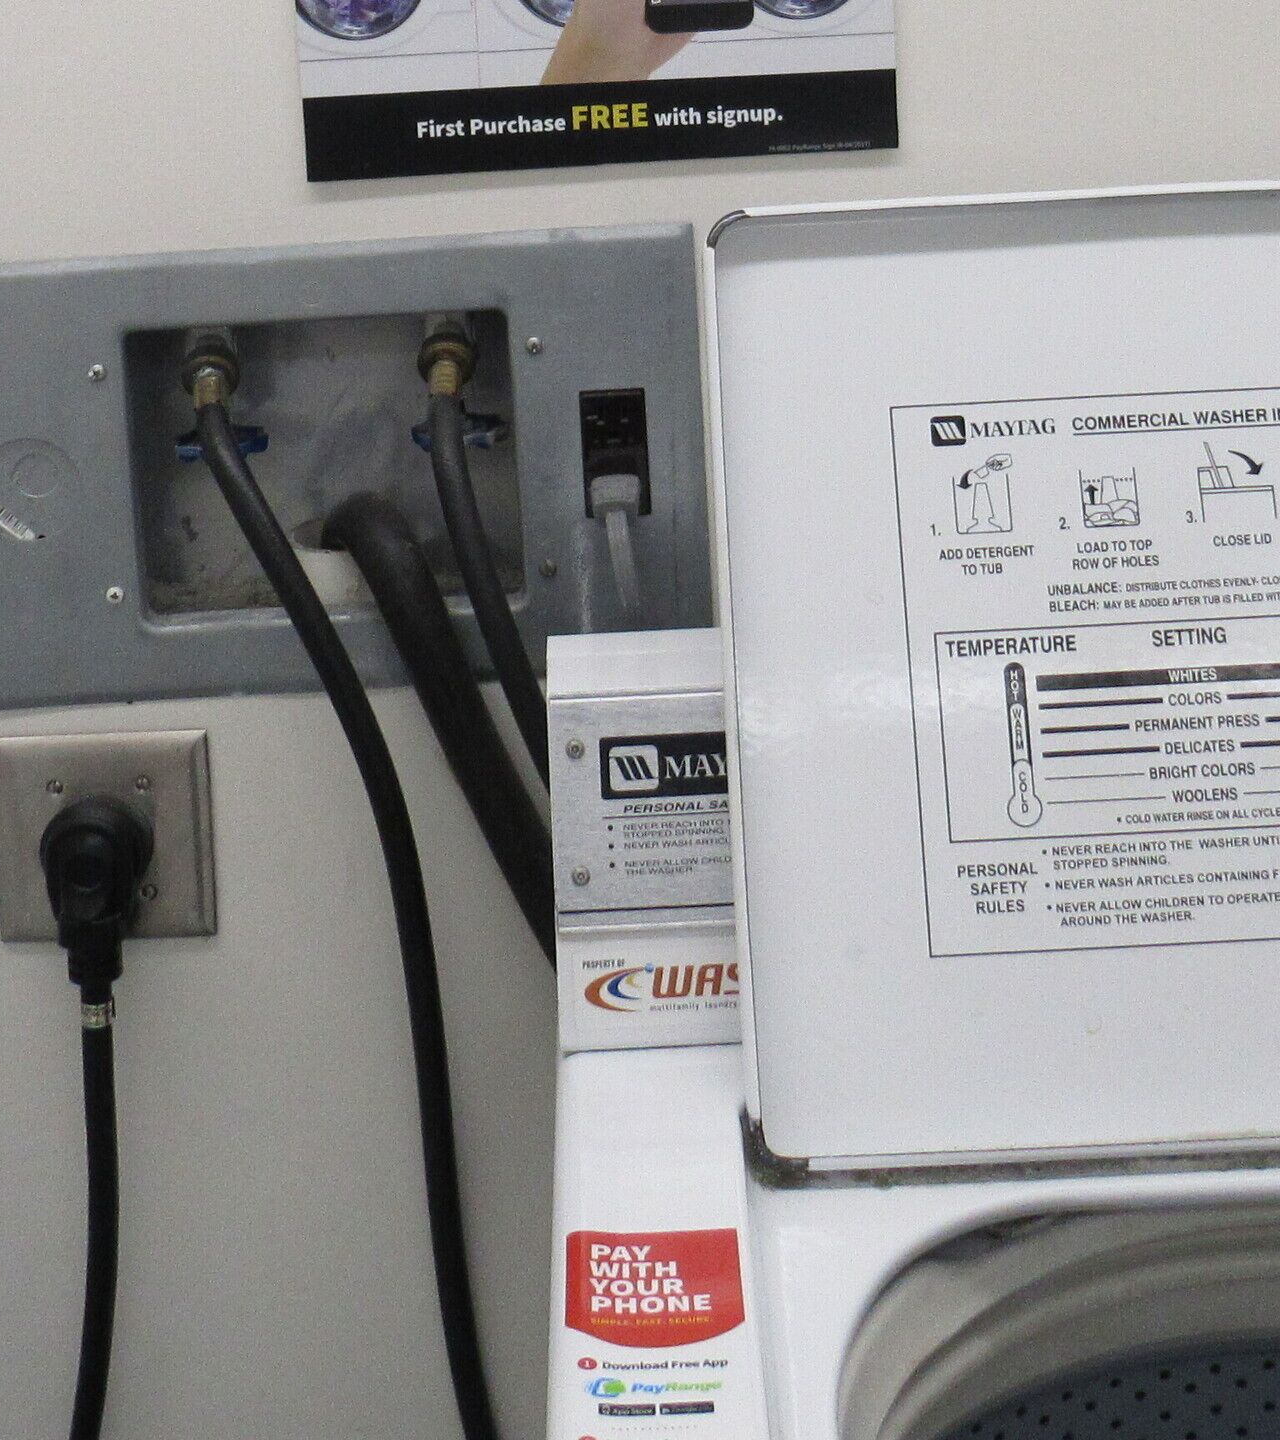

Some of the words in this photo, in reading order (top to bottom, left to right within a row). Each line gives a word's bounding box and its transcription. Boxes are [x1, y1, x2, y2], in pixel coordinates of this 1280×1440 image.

[416, 120, 464, 138] First
[470, 115, 566, 135] Purchase
[572, 103, 648, 130] FREE
[655, 107, 702, 127] with
[707, 106, 783, 128] signup.
[1072, 413, 1189, 431] COMMERCIAL
[1194, 409, 1267, 425] WASHER
[970, 418, 1055, 438] MAYTAG
[1059, 517, 1070, 530] 2.
[1186, 511, 1198, 523] 3.
[930, 524, 941, 536] 1.
[1077, 542, 1109, 554] LOAD
[1112, 541, 1127, 551] TO
[1130, 540, 1152, 550] TOP
[1213, 535, 1252, 547] CLOSE
[1254, 533, 1271, 544] LID
[939, 548, 963, 560] ADD
[966, 545, 1034, 559] DETERGENT
[962, 565, 978, 575] TO
[981, 564, 1002, 574] TUB
[1072, 559, 1100, 570] ROW
[1103, 558, 1117, 568] OF
[1122, 555, 1159, 567] HOLES
[1152, 627, 1227, 647] SETTING
[945, 635, 1077, 657] TEMPERATURE
[1168, 669, 1217, 682] WHITES
[1168, 692, 1222, 706] COLORS
[1135, 717, 1215, 731] PERMANENT
[1219, 714, 1260, 728] PRESS
[1164, 740, 1235, 754] DELICATES
[1150, 765, 1197, 780] BRIGHT
[1201, 763, 1255, 777] COLORS
[1172, 788, 1238, 803] WOOLENS
[624, 801, 704, 813] PERSONAL
[1052, 845, 1091, 856] NEVER
[1095, 843, 1136, 854] REACH
[1139, 842, 1166, 851] INTO
[1170, 840, 1192, 850] THE
[1199, 837, 1249, 849] WASHER
[957, 862, 1038, 877] PERSONAL
[1053, 859, 1108, 870] STOPPED
[1112, 856, 1170, 867] SPINNING.
[1055, 879, 1095, 890] NEVER
[1098, 877, 1133, 888] WASH
[1137, 874, 1194, 886] ARTICLES
[1198, 870, 1269, 883] CONTAINING
[971, 881, 1028, 896] SAFETY
[975, 899, 1025, 914] RULES
[591, 1244, 652, 1260] PAY
[589, 1262, 677, 1278] WITH
[589, 1279, 684, 1295] YOUR
[591, 1294, 712, 1313] PHONE
[703, 1359, 728, 1367] App
